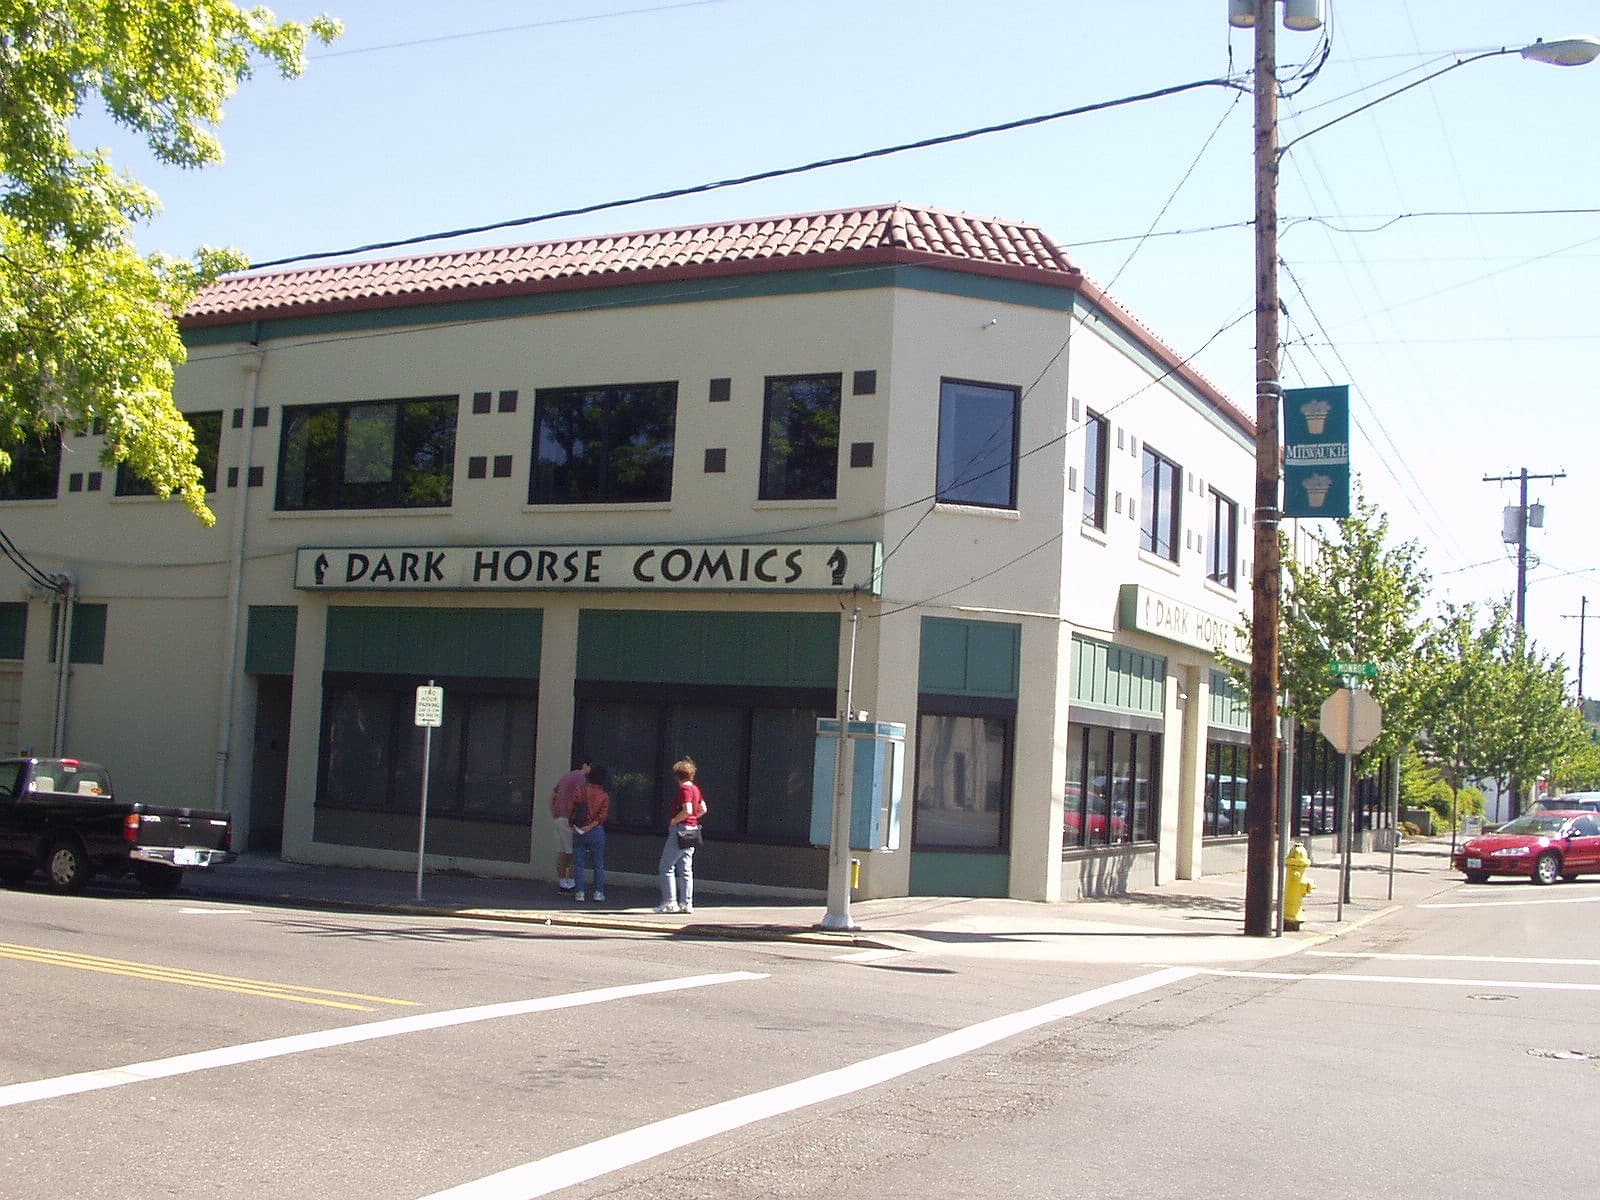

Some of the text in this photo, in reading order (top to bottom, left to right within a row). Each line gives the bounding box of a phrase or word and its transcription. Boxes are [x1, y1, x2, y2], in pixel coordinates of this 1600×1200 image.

[346, 548, 802, 584] DARK HORSE COMICS
[1155, 599, 1189, 635] DARK
[1196, 613, 1229, 649] HORSE
